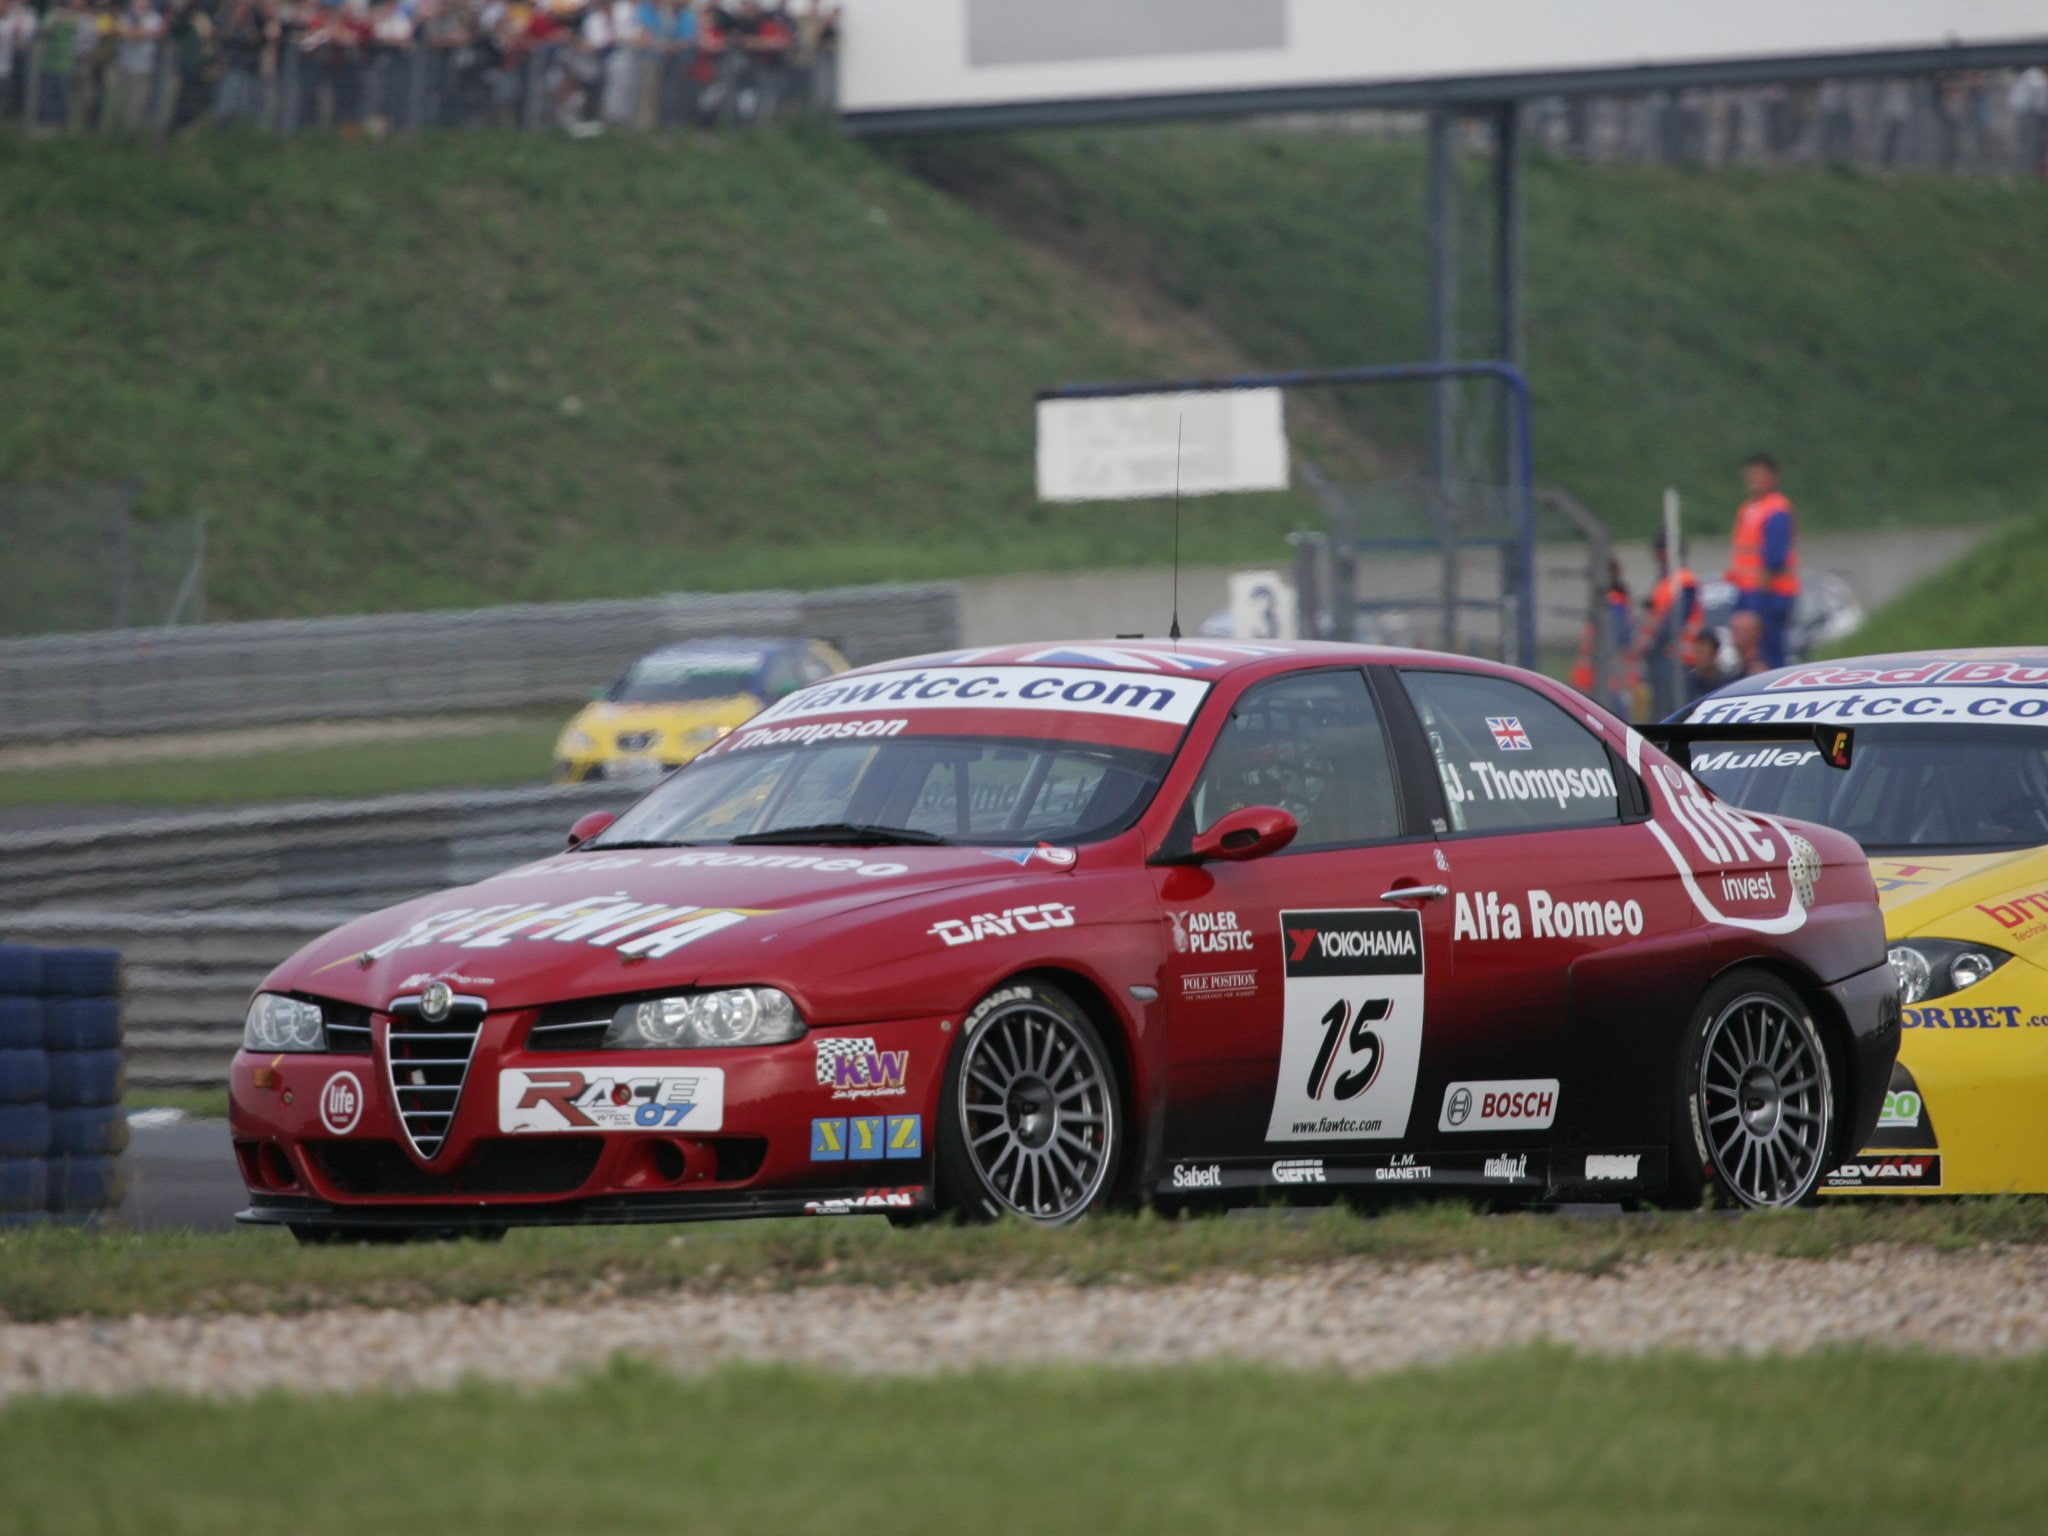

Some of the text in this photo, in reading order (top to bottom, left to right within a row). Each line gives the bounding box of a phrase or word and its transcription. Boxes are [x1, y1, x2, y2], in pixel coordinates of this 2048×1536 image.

[1764, 662, 1952, 689] Red
[768, 673, 1176, 718] fiawtcc.com
[1699, 695, 2048, 724] fiawtcc.co
[727, 719, 909, 753] Thompson
[1691, 748, 1822, 772] Muller
[1448, 761, 1618, 809] J. Thompson
[650, 851, 909, 877] Romeo
[1721, 871, 1776, 901] invest
[927, 902, 1076, 946] DAYCO
[1189, 911, 1239, 932] ADLER
[1453, 889, 1644, 941] Alfa Romeo
[1190, 930, 1254, 953] PLASTIC
[1317, 929, 1416, 957] YOKOHAMA
[1183, 973, 1256, 991] POLE POSITION
[964, 986, 1032, 1035] ADVAN
[1307, 998, 1394, 1100] 15
[833, 1051, 909, 1089] KW
[330, 1085, 355, 1114] life
[1481, 1092, 1553, 1118] BOSCH
[634, 1103, 697, 1126] 07
[1292, 1117, 1382, 1133] www.fiawtcc.com
[1272, 1159, 1327, 1183] GIEFFE
[1375, 1166, 1431, 1180] GIANETTI
[1391, 1154, 1416, 1166] L.M.
[1484, 1153, 1527, 1183] mailup.it
[1826, 1164, 1923, 1178] ADVAN
[1173, 1164, 1222, 1188] Sabelt
